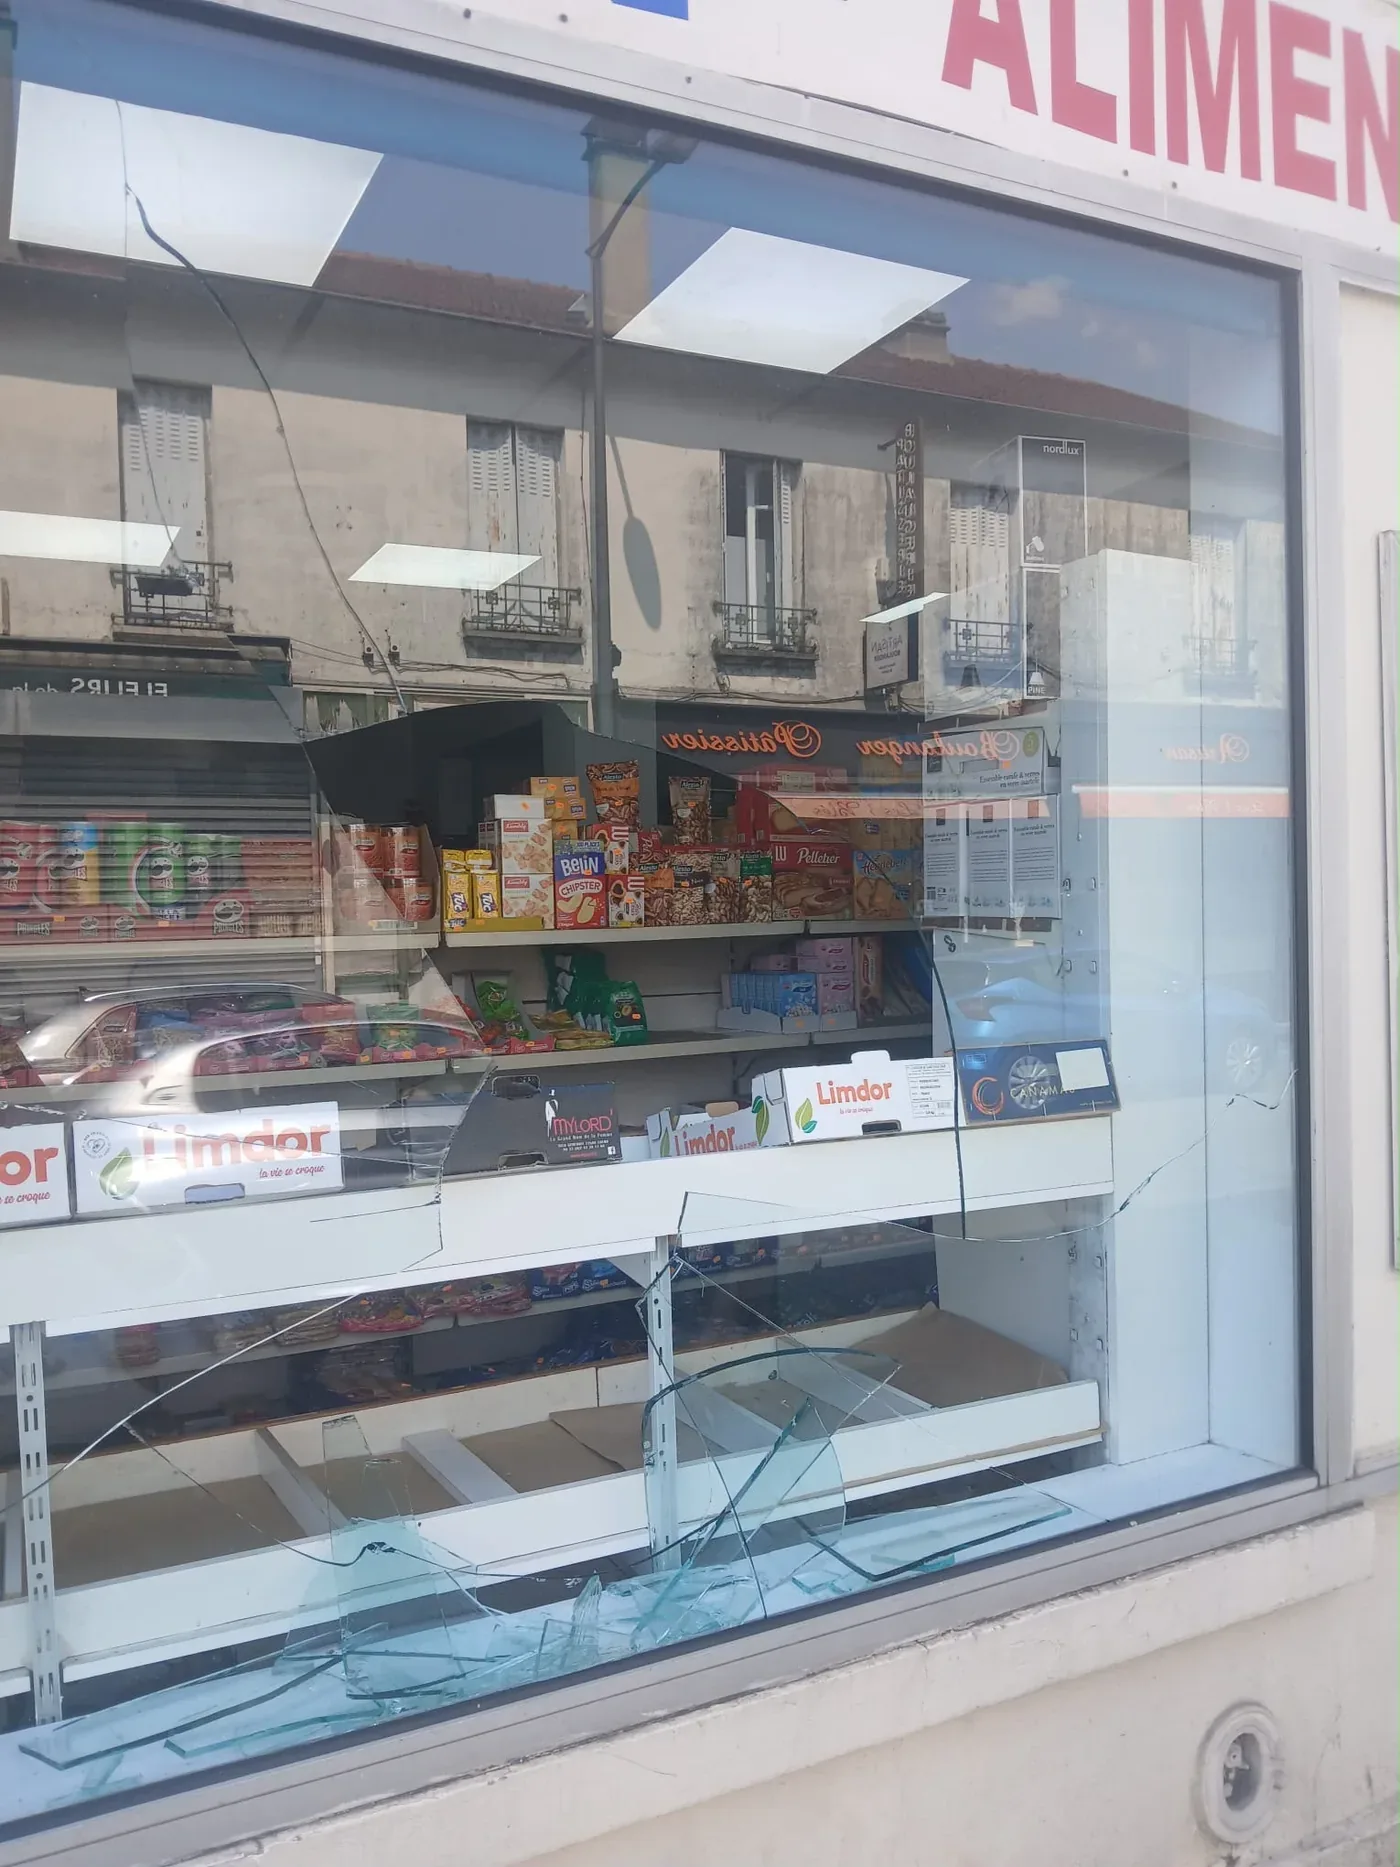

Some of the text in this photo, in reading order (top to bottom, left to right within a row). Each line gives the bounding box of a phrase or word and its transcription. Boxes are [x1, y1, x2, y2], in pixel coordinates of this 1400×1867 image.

[1043, 440, 1080, 454] nordlux
[612, 826, 629, 840] LU
[775, 845, 787, 862] LU
[797, 847, 841, 866] Pelletier
[561, 881, 601, 896] CHIPSTER
[628, 876, 645, 891] LU
[213, 920, 244, 934] PRINGLES
[816, 1079, 893, 1105] Limdor
[295, 1164, 325, 1176] croque
[16, 1191, 51, 1204] croque
